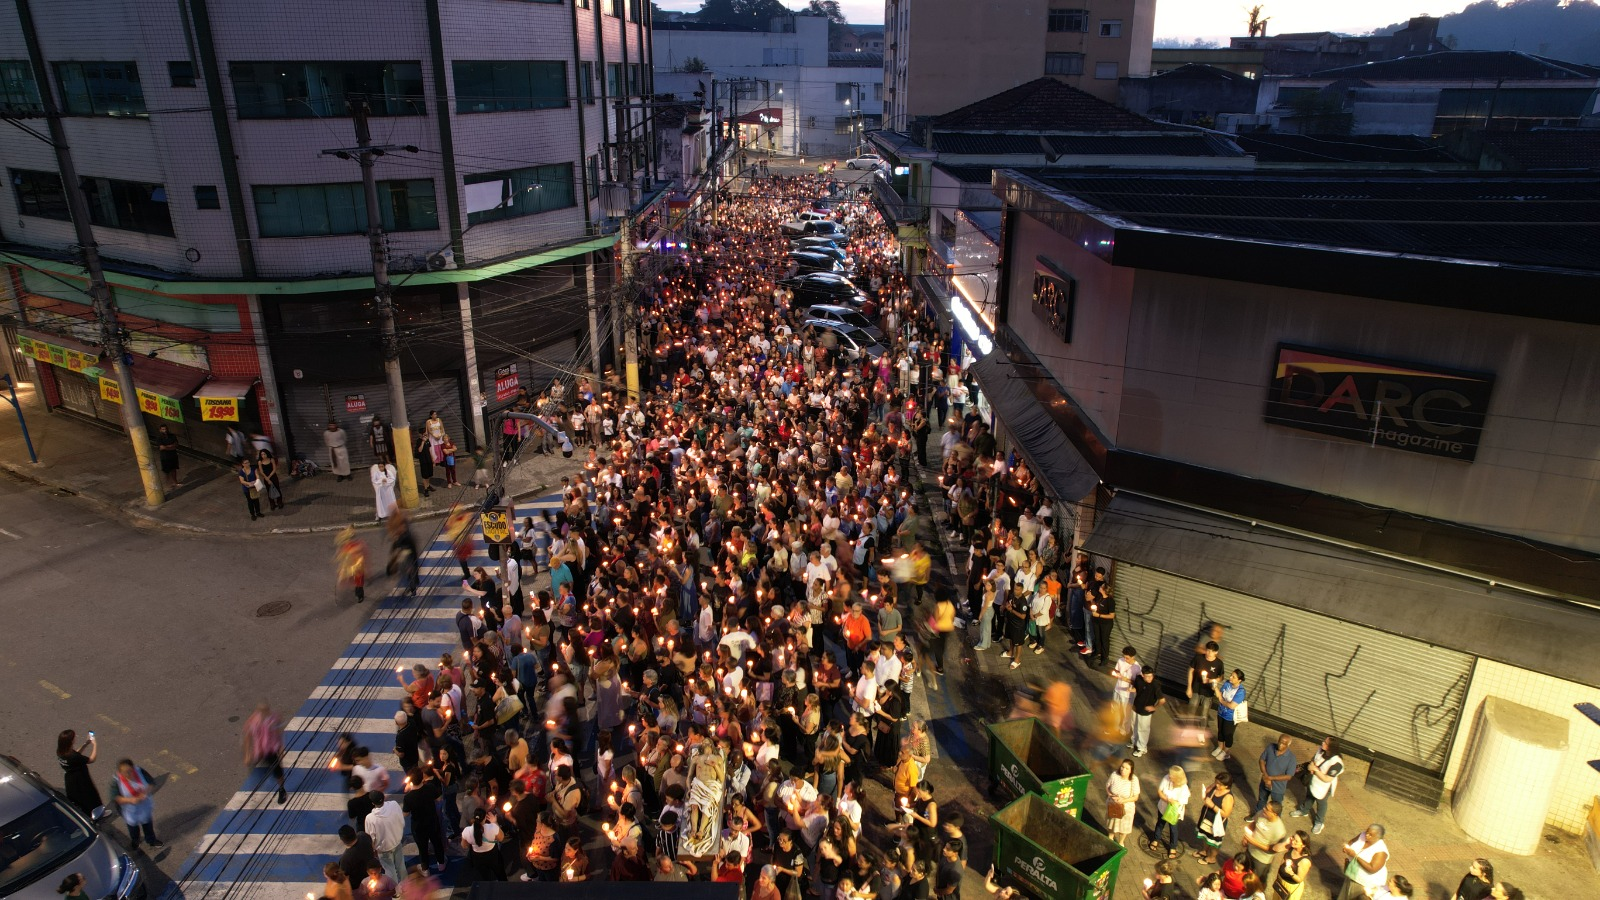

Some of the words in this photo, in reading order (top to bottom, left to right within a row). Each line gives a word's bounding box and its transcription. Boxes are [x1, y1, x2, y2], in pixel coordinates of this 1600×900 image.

[497, 376, 519, 393] ALUGA
[1280, 365, 1472, 436] DARC
[1367, 426, 1464, 454] magazine
[1001, 763, 1026, 795] PERALTA
[1014, 855, 1058, 892] PERALTA
